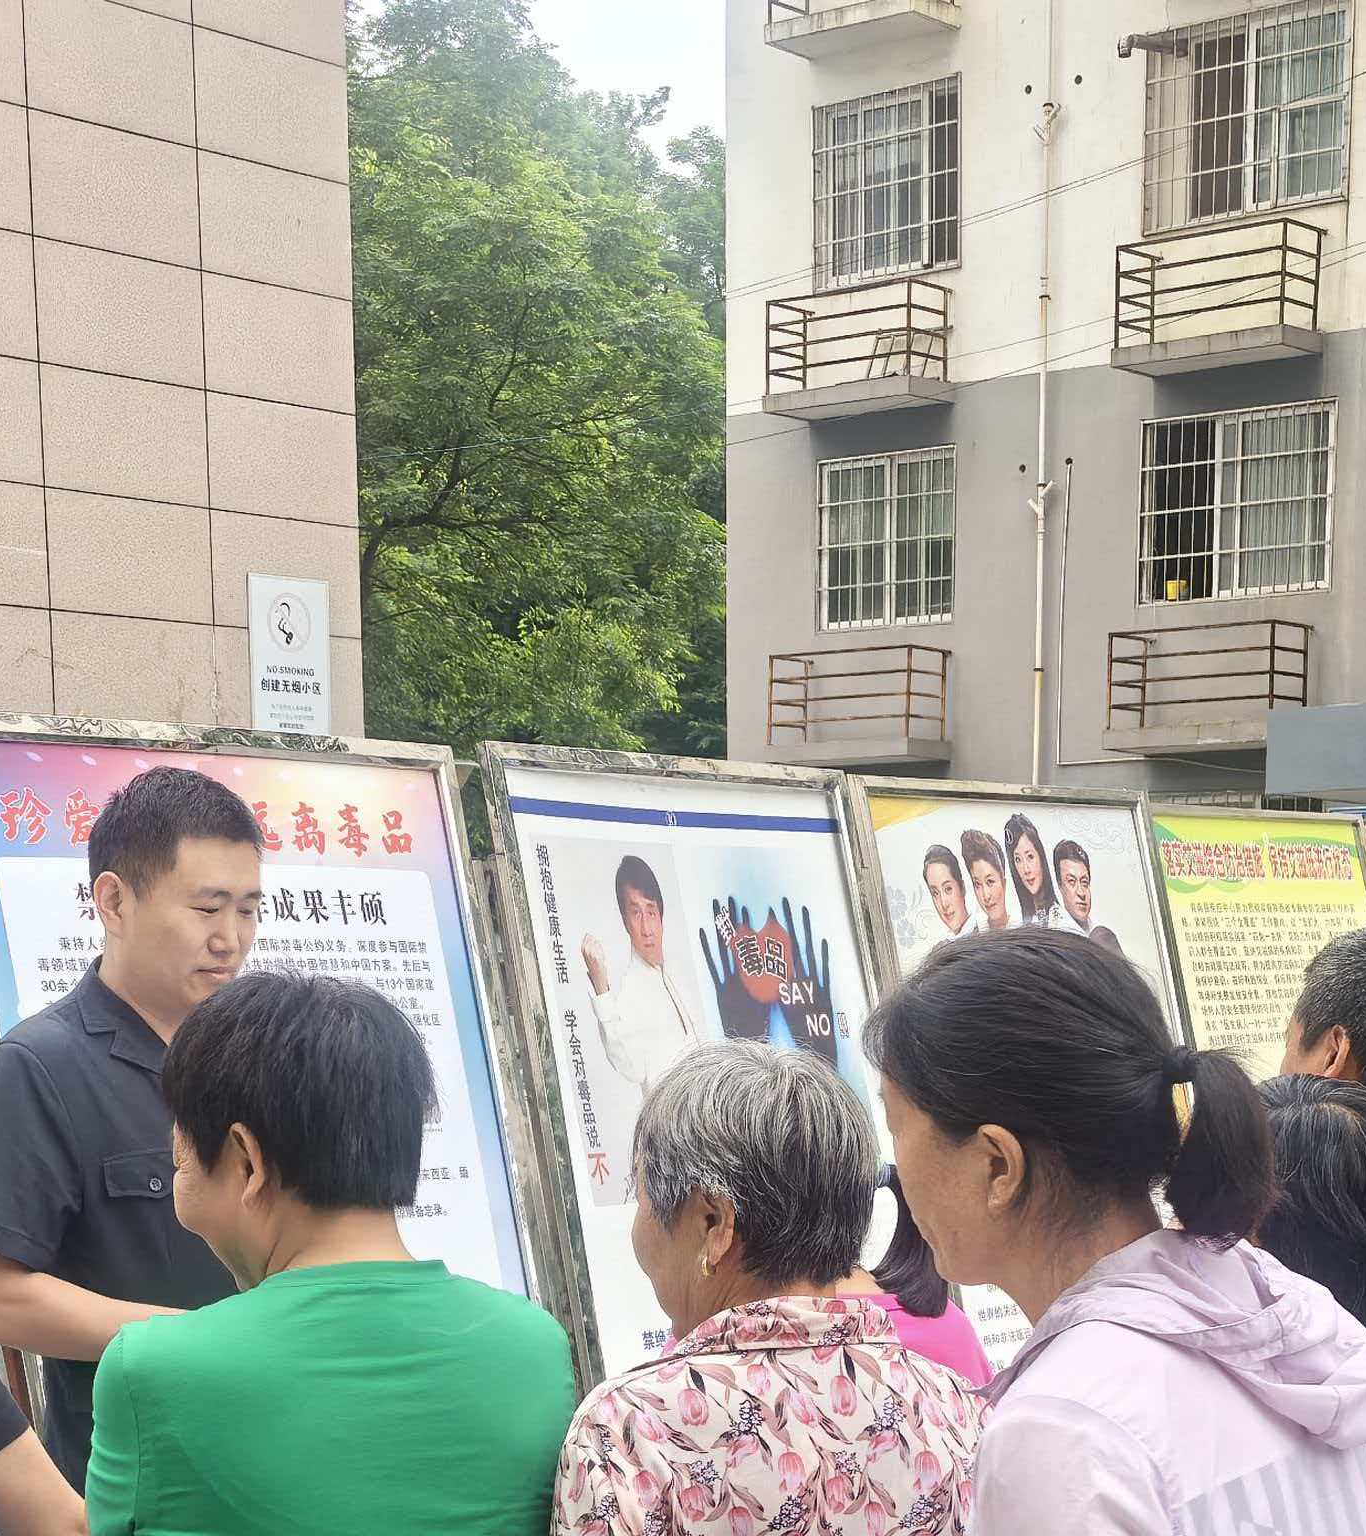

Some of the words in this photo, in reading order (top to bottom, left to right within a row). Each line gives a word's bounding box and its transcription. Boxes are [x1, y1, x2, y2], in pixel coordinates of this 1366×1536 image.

[261, 678, 321, 695] 创建无烟小区
[535, 843, 570, 985] 拥抱健康生活
[778, 980, 815, 1005] SAY
[806, 1013, 832, 1037] NO
